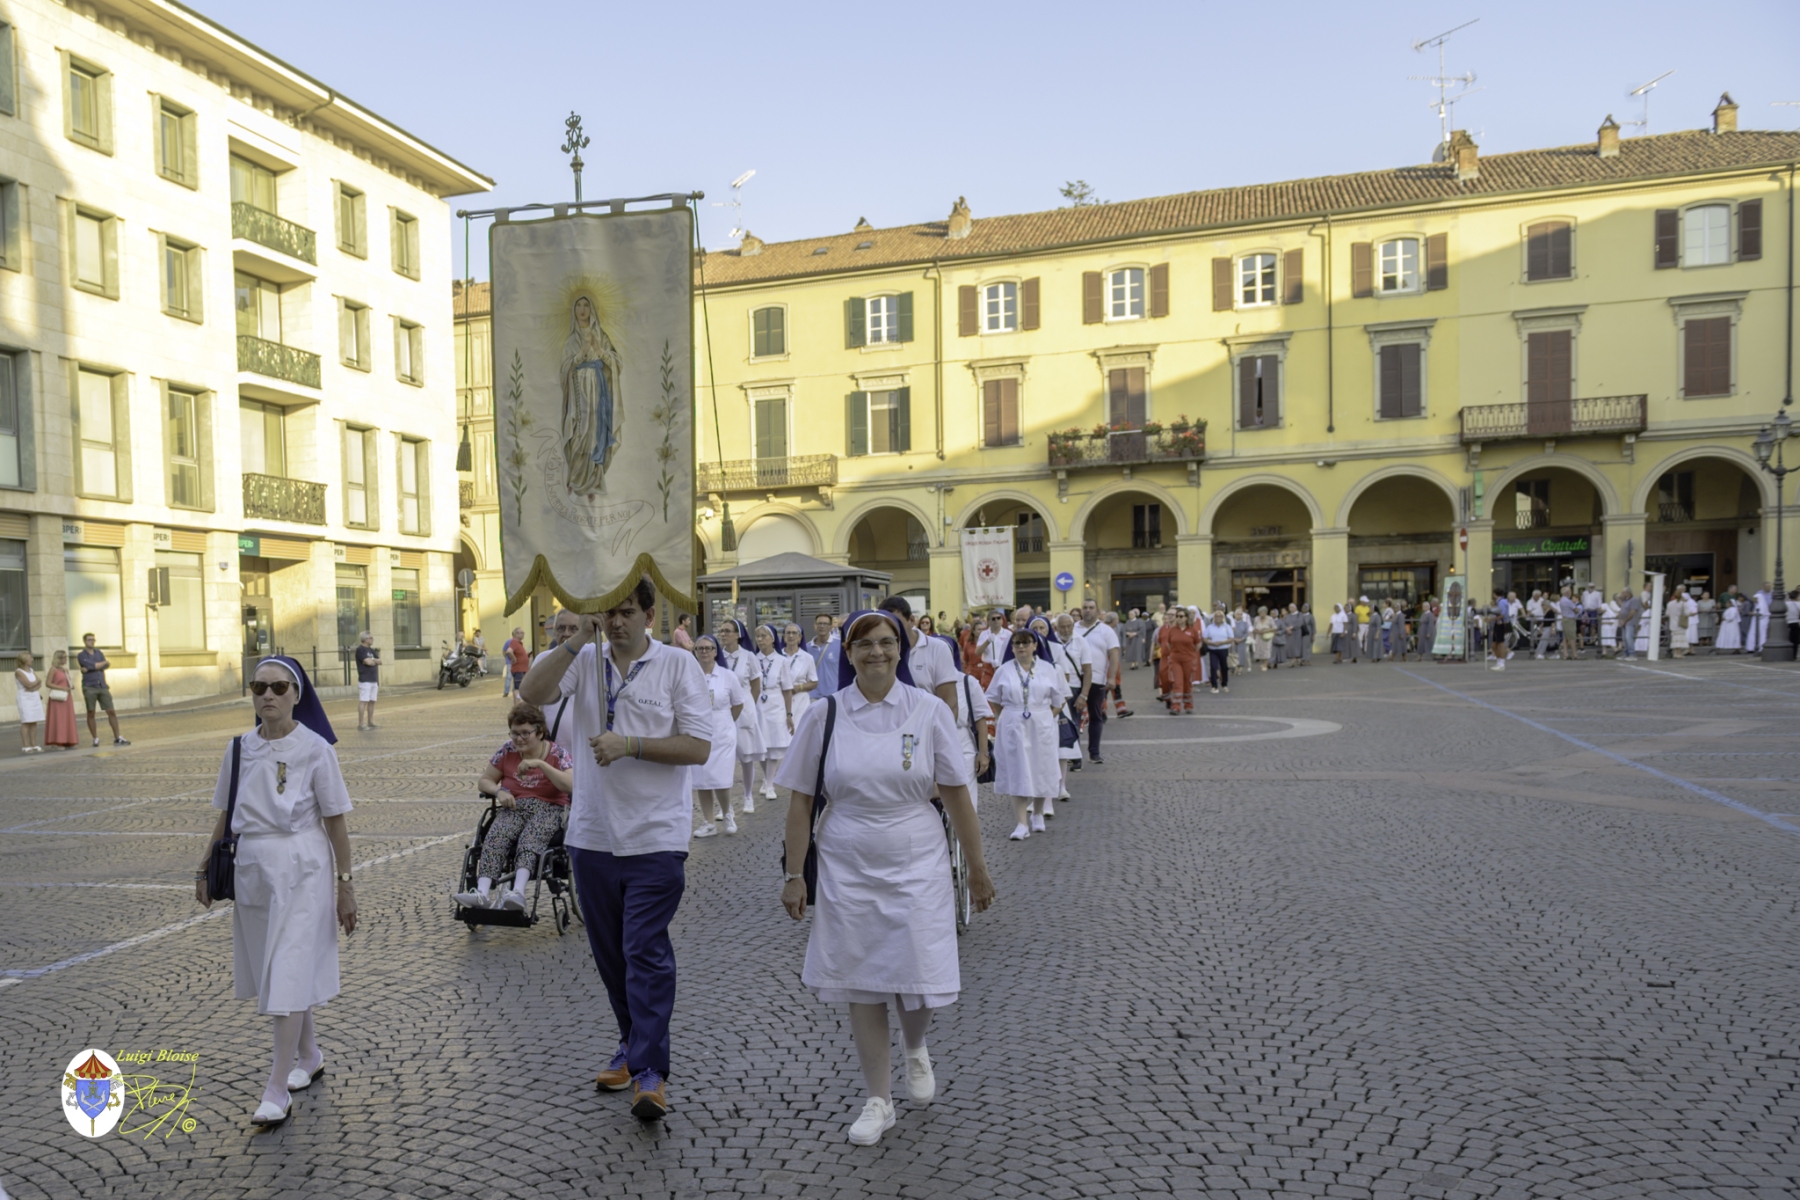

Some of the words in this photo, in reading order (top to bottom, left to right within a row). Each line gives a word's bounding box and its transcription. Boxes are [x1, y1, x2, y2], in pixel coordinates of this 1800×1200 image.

[546, 479, 569, 517] LOURDES
[568, 507, 599, 526] PREGATE
[599, 513, 617, 525] PER
[617, 509, 631, 520] NOI
[1542, 536, 1588, 551] Centrale
